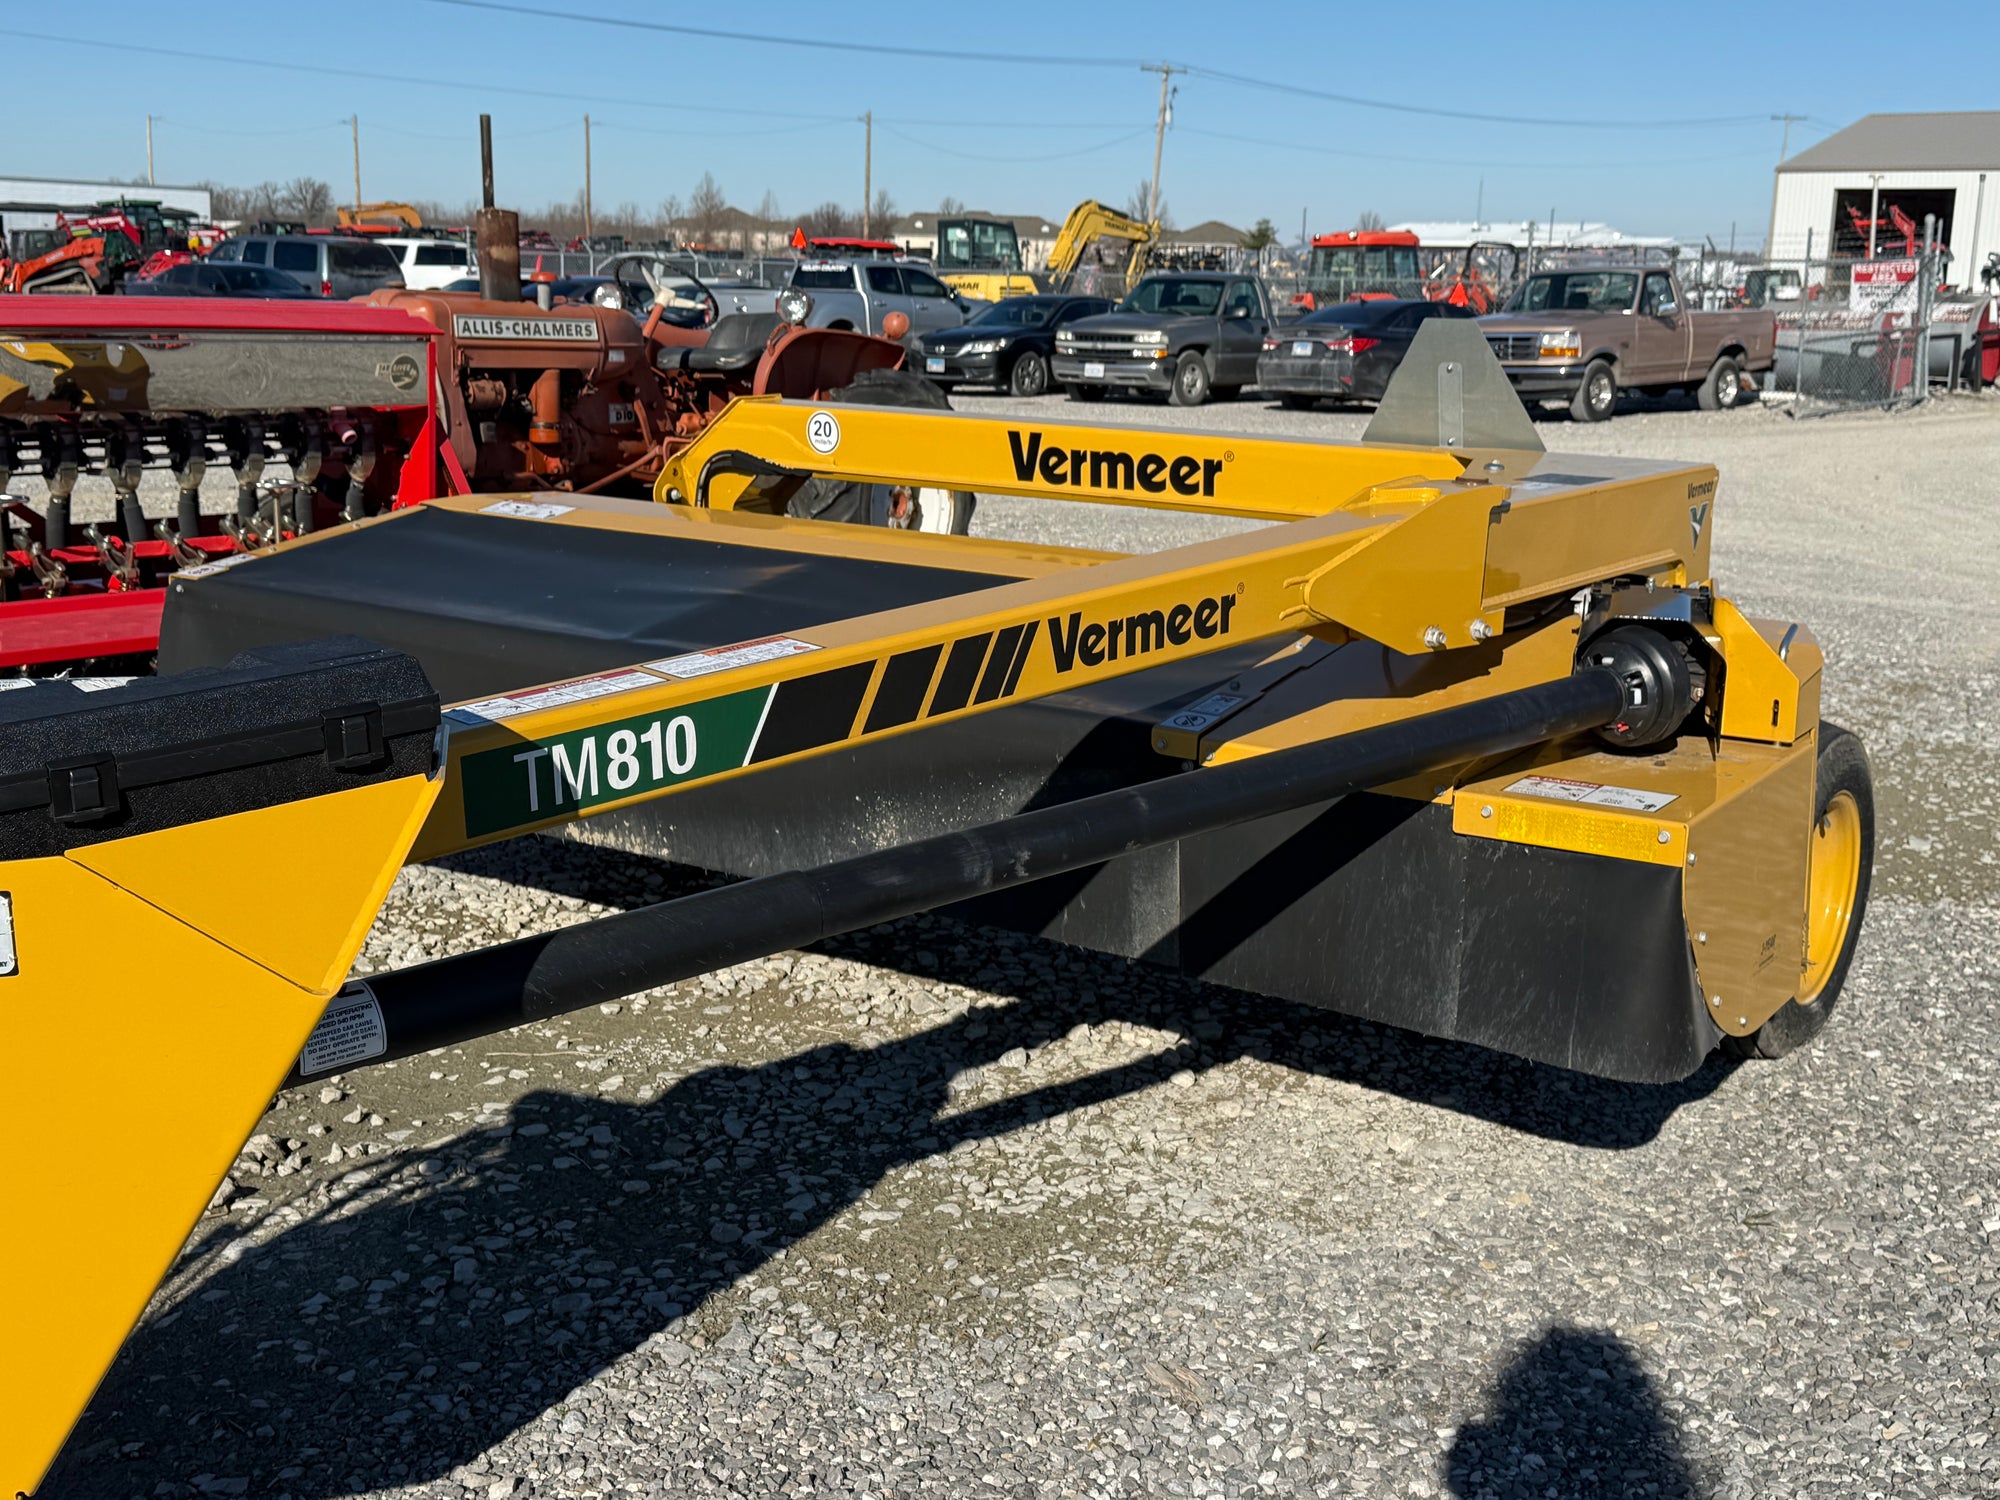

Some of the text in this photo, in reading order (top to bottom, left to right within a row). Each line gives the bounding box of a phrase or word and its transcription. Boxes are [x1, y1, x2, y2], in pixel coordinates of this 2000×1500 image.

[1855, 262, 1915, 273] RESTRICTED
[1871, 273, 1897, 283] AREA
[1871, 300, 1895, 308] ONLY
[814, 420, 832, 437] 20
[1007, 430, 1223, 497] Vermeer
[1688, 481, 1714, 500] Vermeer
[1048, 594, 1236, 674] Vermeer
[1546, 778, 1599, 789] DANGER
[336, 1003, 373, 1018] OPERATING
[337, 1017, 348, 1026] 540
[349, 1012, 365, 1023] RPM
[342, 1022, 354, 1032] CAN
[355, 1019, 373, 1029] CAUSE
[307, 1024, 378, 1049] SEVERE INJURY OR DEATH
[318, 1044, 331, 1053] NOT
[333, 1037, 360, 1048] OPERATE
